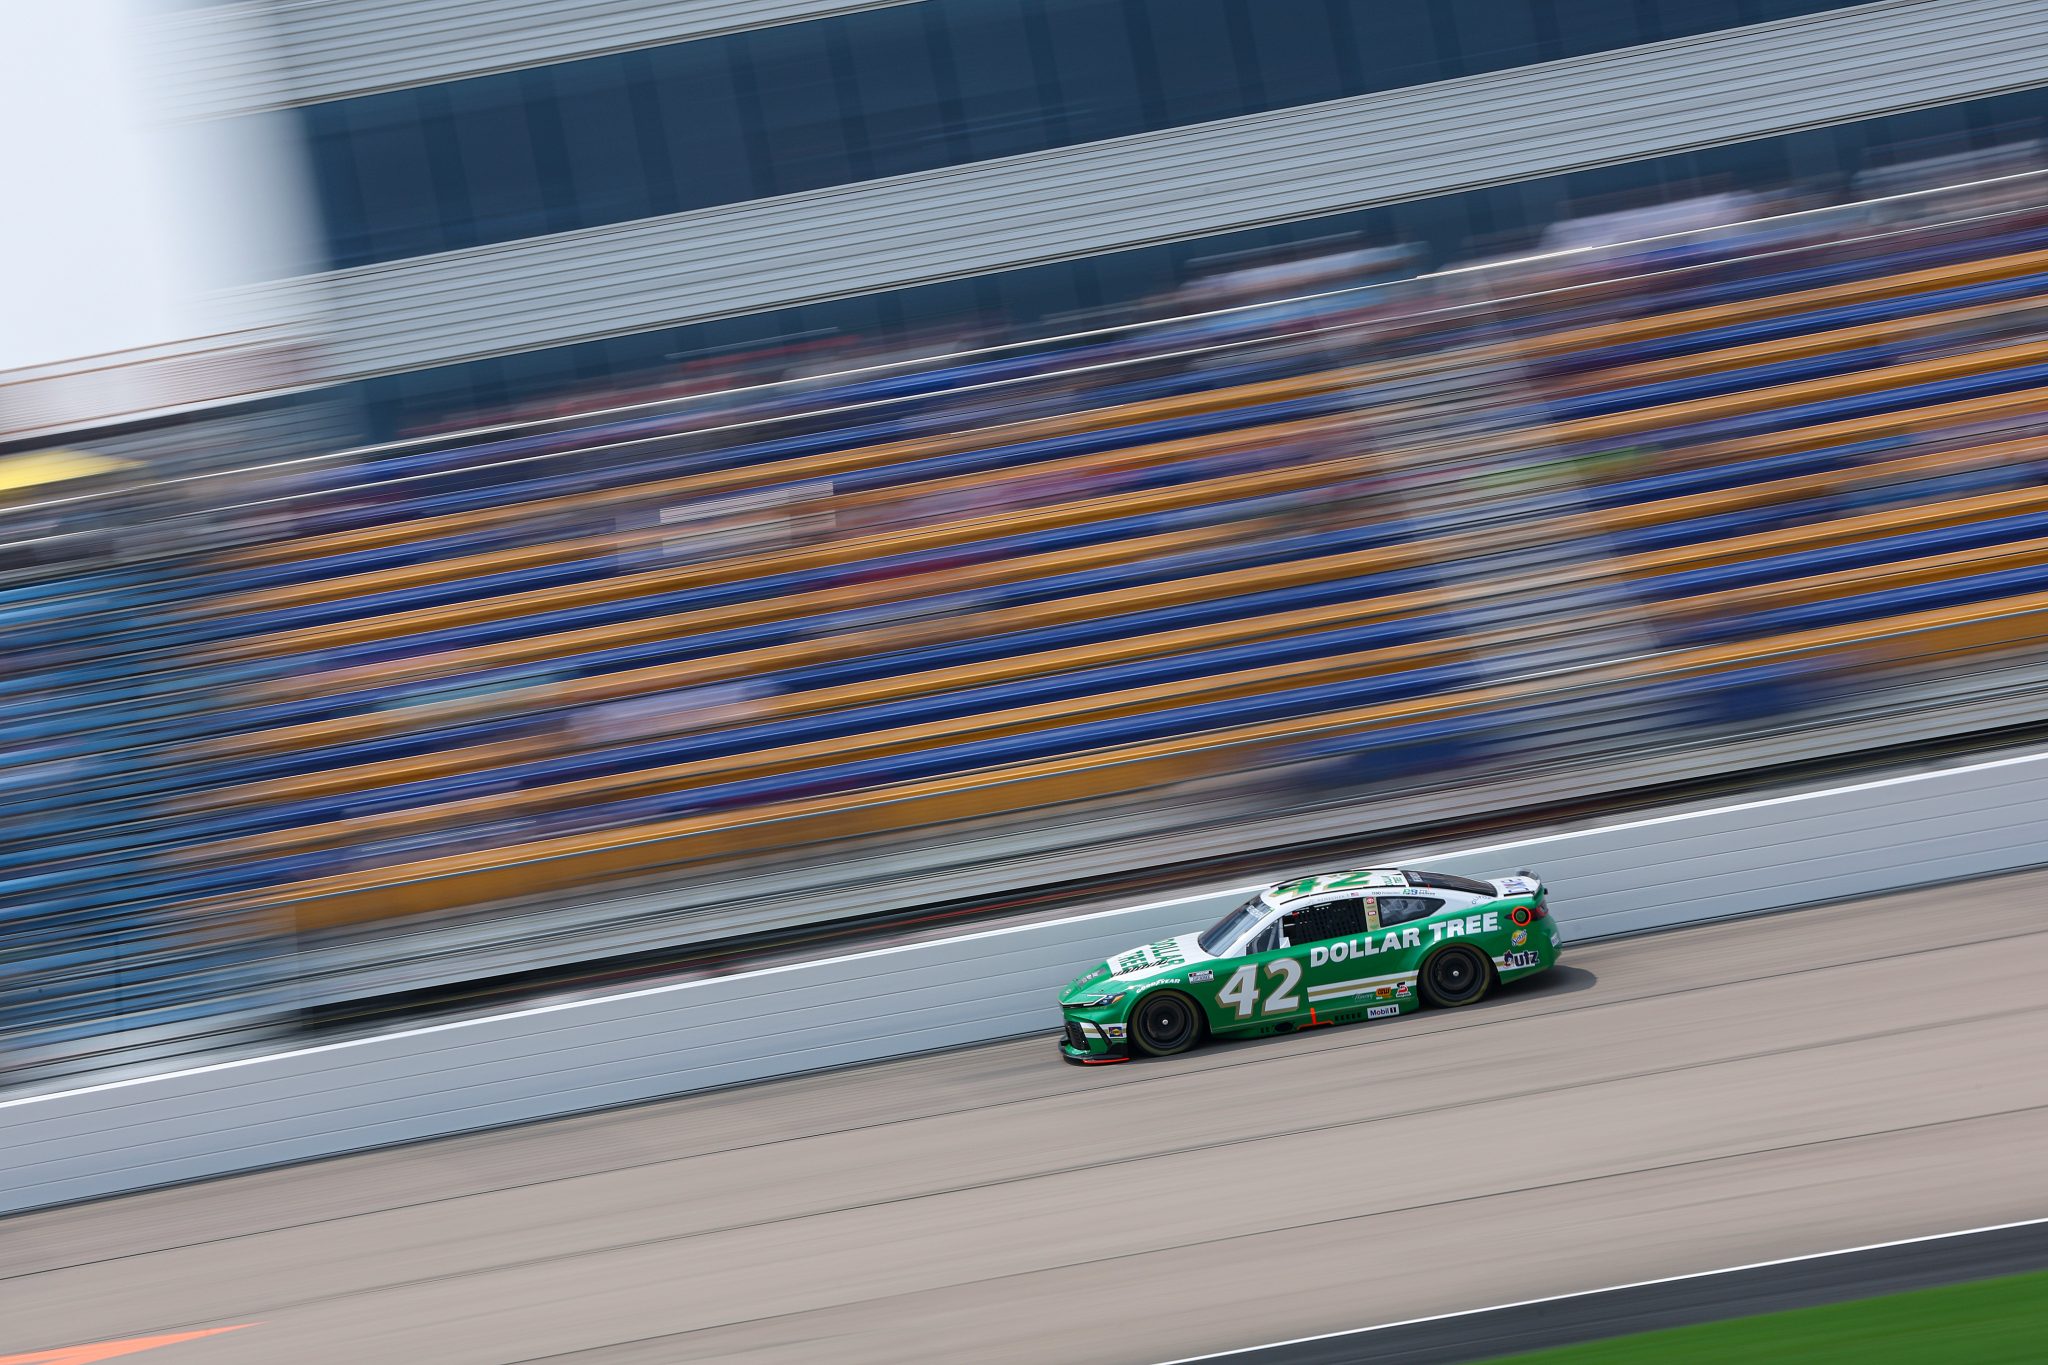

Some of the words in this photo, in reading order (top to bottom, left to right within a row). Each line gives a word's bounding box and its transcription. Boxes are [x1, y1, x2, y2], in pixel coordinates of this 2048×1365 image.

[1269, 871, 1373, 897] 42
[1311, 927, 1421, 968] DOLLAR
[1428, 911, 1499, 943] TREE
[1136, 978, 1181, 994] GOODYEAR
[1216, 958, 1301, 1019] 42
[1369, 1007, 1390, 1017] Mobil
